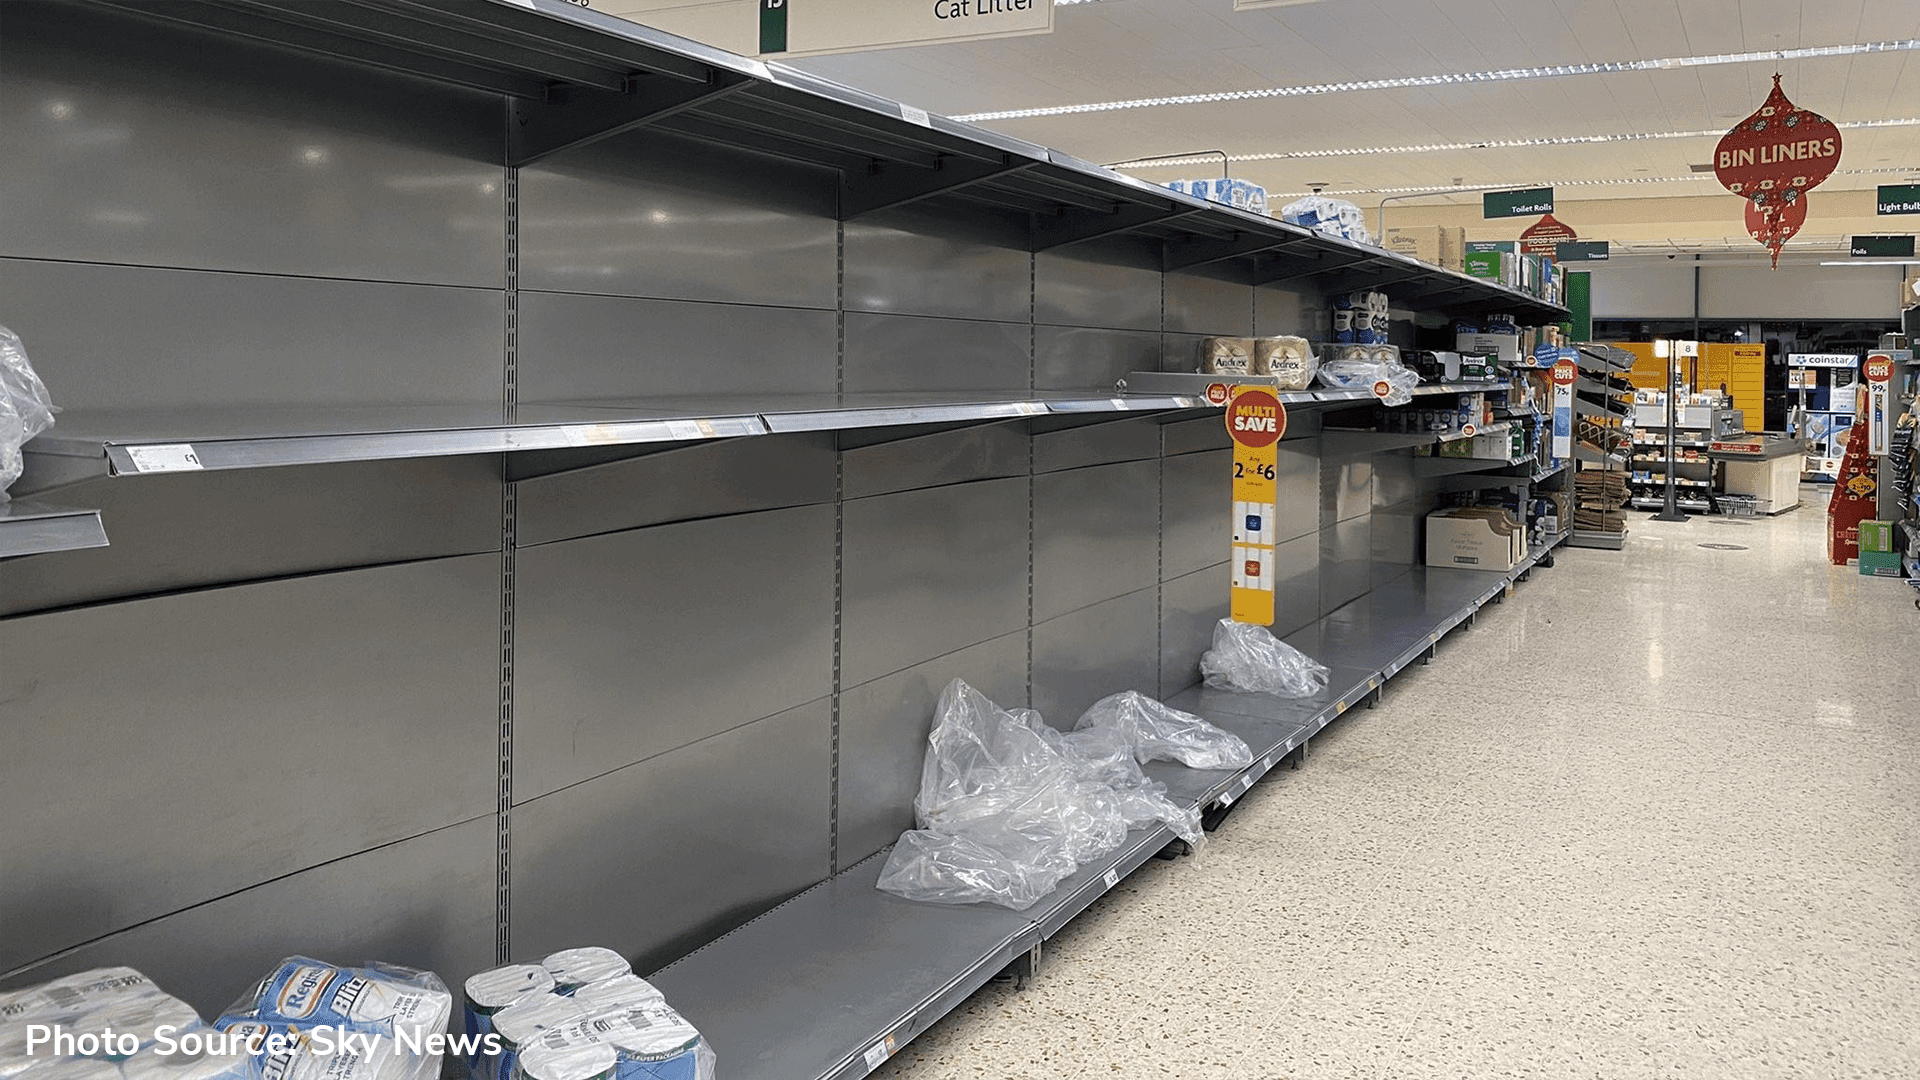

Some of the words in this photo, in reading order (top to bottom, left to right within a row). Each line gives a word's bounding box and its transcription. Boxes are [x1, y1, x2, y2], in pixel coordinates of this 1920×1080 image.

[935, 0, 970, 19] Cat
[1719, 148, 1755, 169] BIN
[1761, 138, 1835, 164] LINERS
[1512, 205, 1532, 213] Toilet
[1534, 203, 1552, 211] Rolls
[1879, 203, 1901, 213] Light
[1685, 345, 1691, 353] 8
[1215, 358, 1248, 368] Andrex
[1808, 354, 1849, 364] coinstar
[1270, 359, 1299, 370] Andrex
[1557, 387, 1570, 395] 75p
[1236, 405, 1276, 417] MULTI
[1234, 416, 1277, 432] SAVE
[1234, 462, 1244, 478] 2
[1257, 463, 1275, 480] £6
